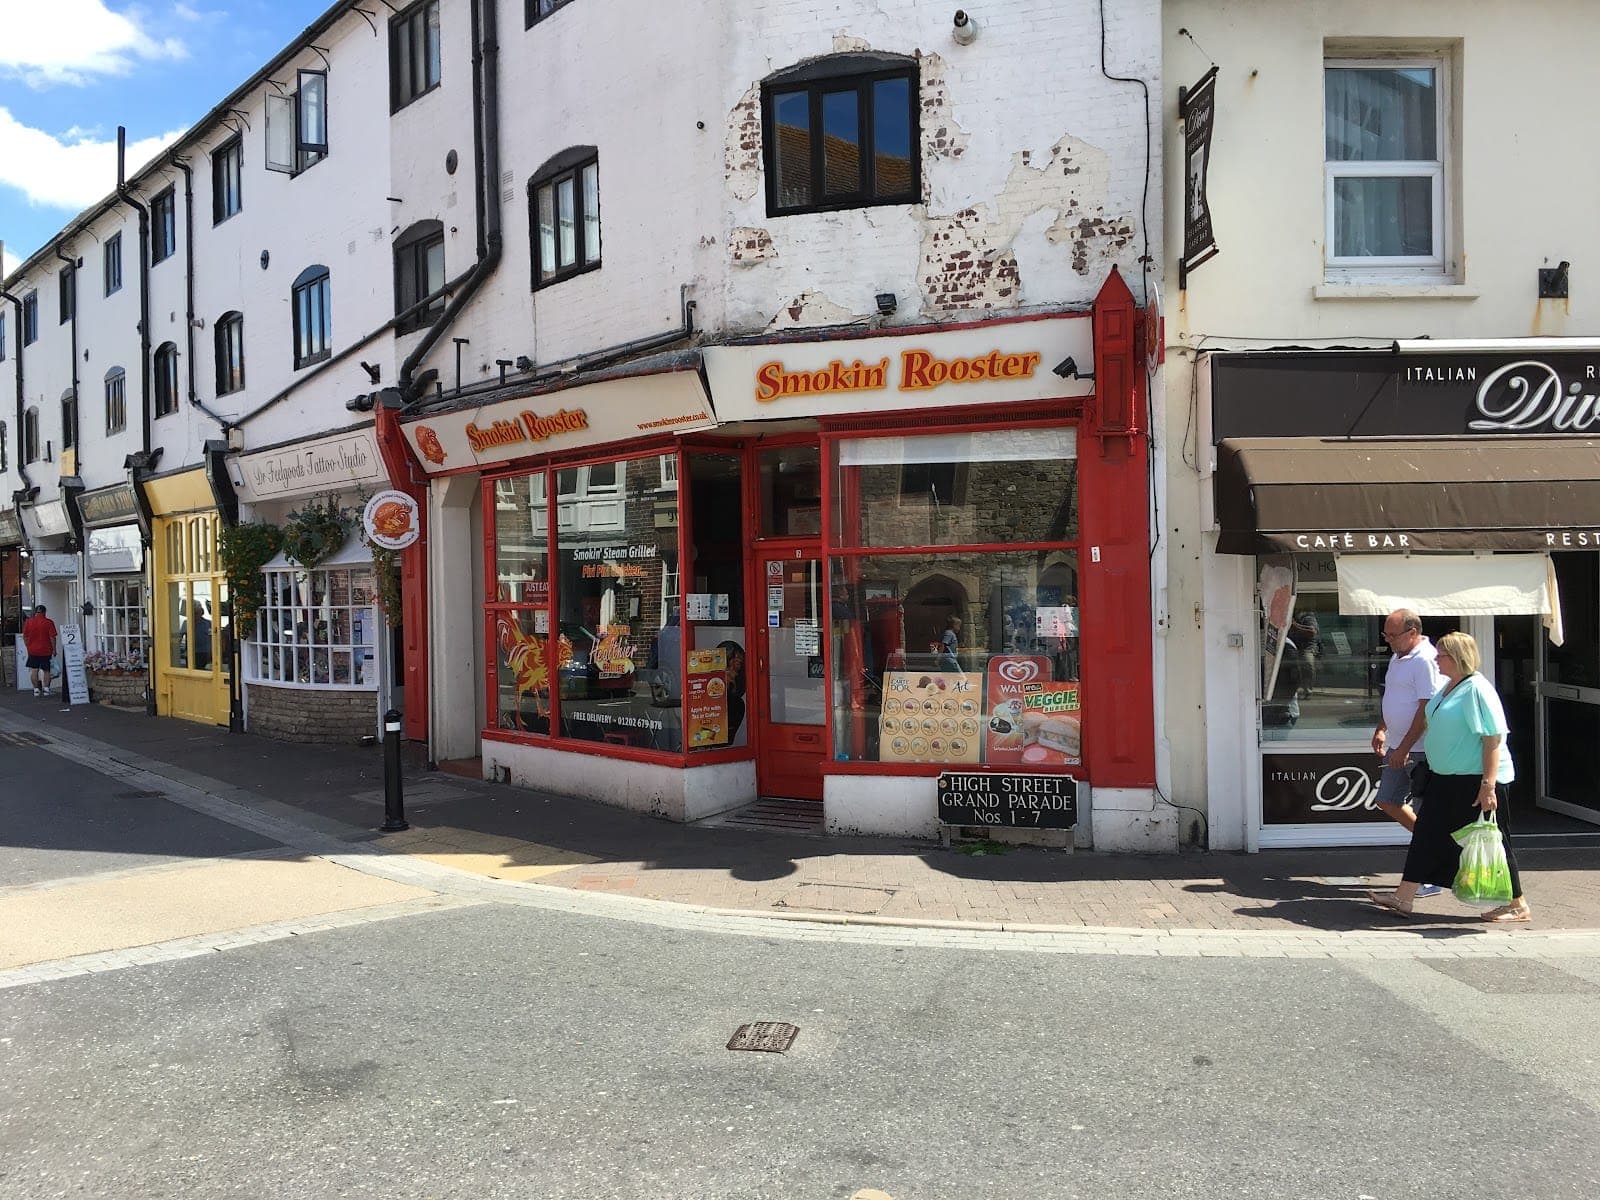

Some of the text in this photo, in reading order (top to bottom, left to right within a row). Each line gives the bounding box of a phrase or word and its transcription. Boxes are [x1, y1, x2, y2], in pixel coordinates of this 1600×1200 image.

[755, 349, 1040, 401] Smokin' Rooster
[1407, 367, 1477, 381] ITALIAN
[1467, 359, 1600, 431] Div
[636, 411, 709, 431] www.smokinrooster.co.uk
[466, 408, 588, 453] Smokin' Rooster
[304, 451, 337, 476] Tattoo
[337, 439, 368, 472] Studio
[1296, 532, 1411, 549] CAFÉ BAR
[1546, 532, 1600, 546] REST
[603, 546, 628, 560] Steam
[628, 543, 657, 558] Grilled
[67, 633, 76, 645] 2
[1000, 684, 1022, 693] WAL
[1024, 690, 1077, 708] VEGGIE
[1044, 703, 1079, 713] BURGERS
[573, 711, 586, 721] FREE
[586, 712, 612, 724] DELIVERY
[617, 717, 636, 728] 01202
[637, 718, 649, 729] 679
[1271, 771, 1317, 781] ITALIAN
[951, 777, 1062, 793] HIGH STREET
[1310, 766, 1383, 811] Di
[942, 792, 1072, 810] GRAND PARADE
[1011, 810, 1016, 824] 1
[1031, 810, 1041, 823] 7
